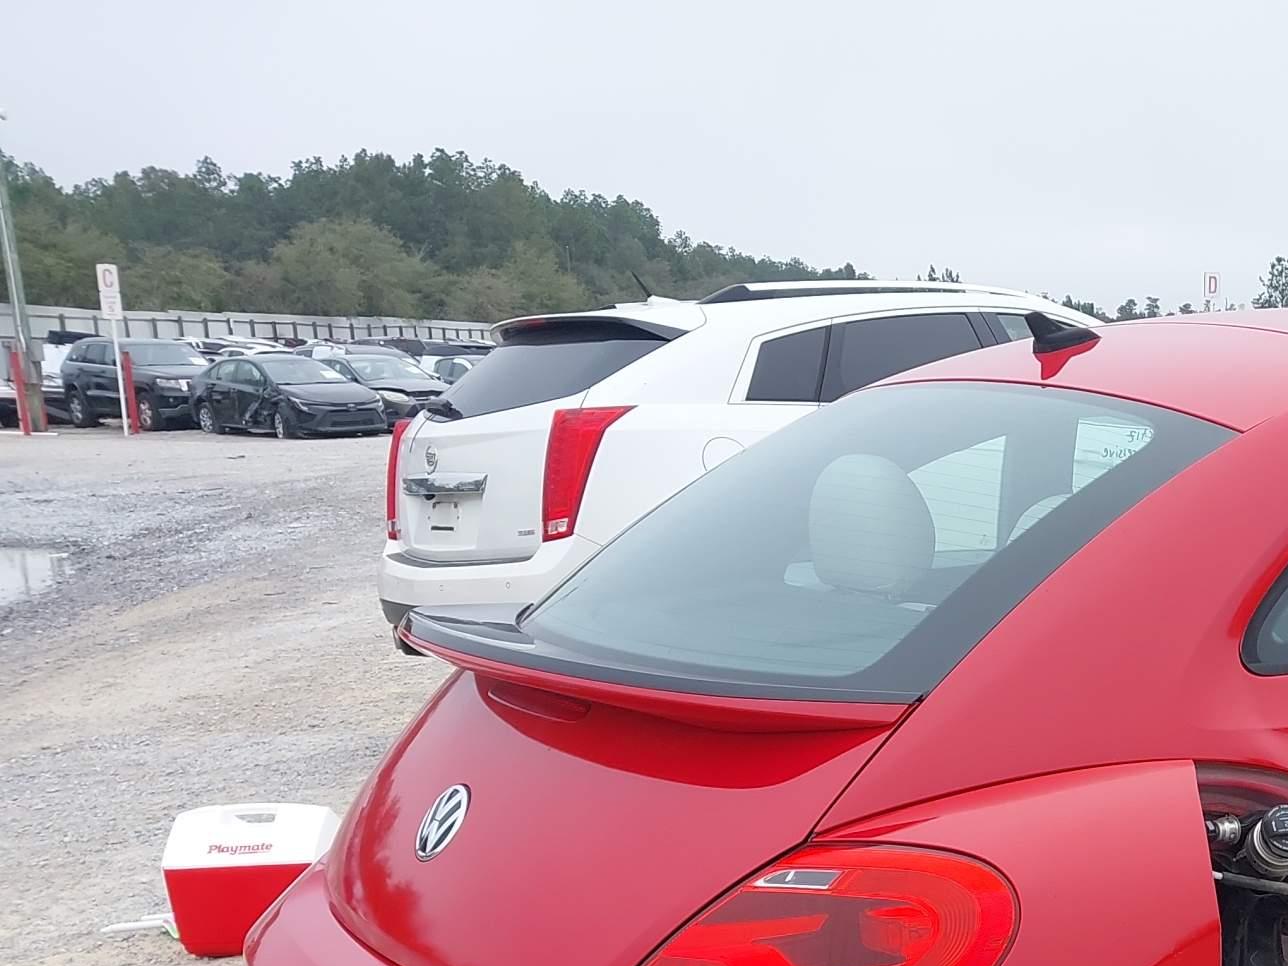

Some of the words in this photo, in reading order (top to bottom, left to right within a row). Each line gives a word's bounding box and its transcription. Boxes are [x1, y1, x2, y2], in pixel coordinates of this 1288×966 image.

[102, 268, 113, 289] C
[1208, 275, 1218, 294] D
[207, 842, 273, 856] Playmate
